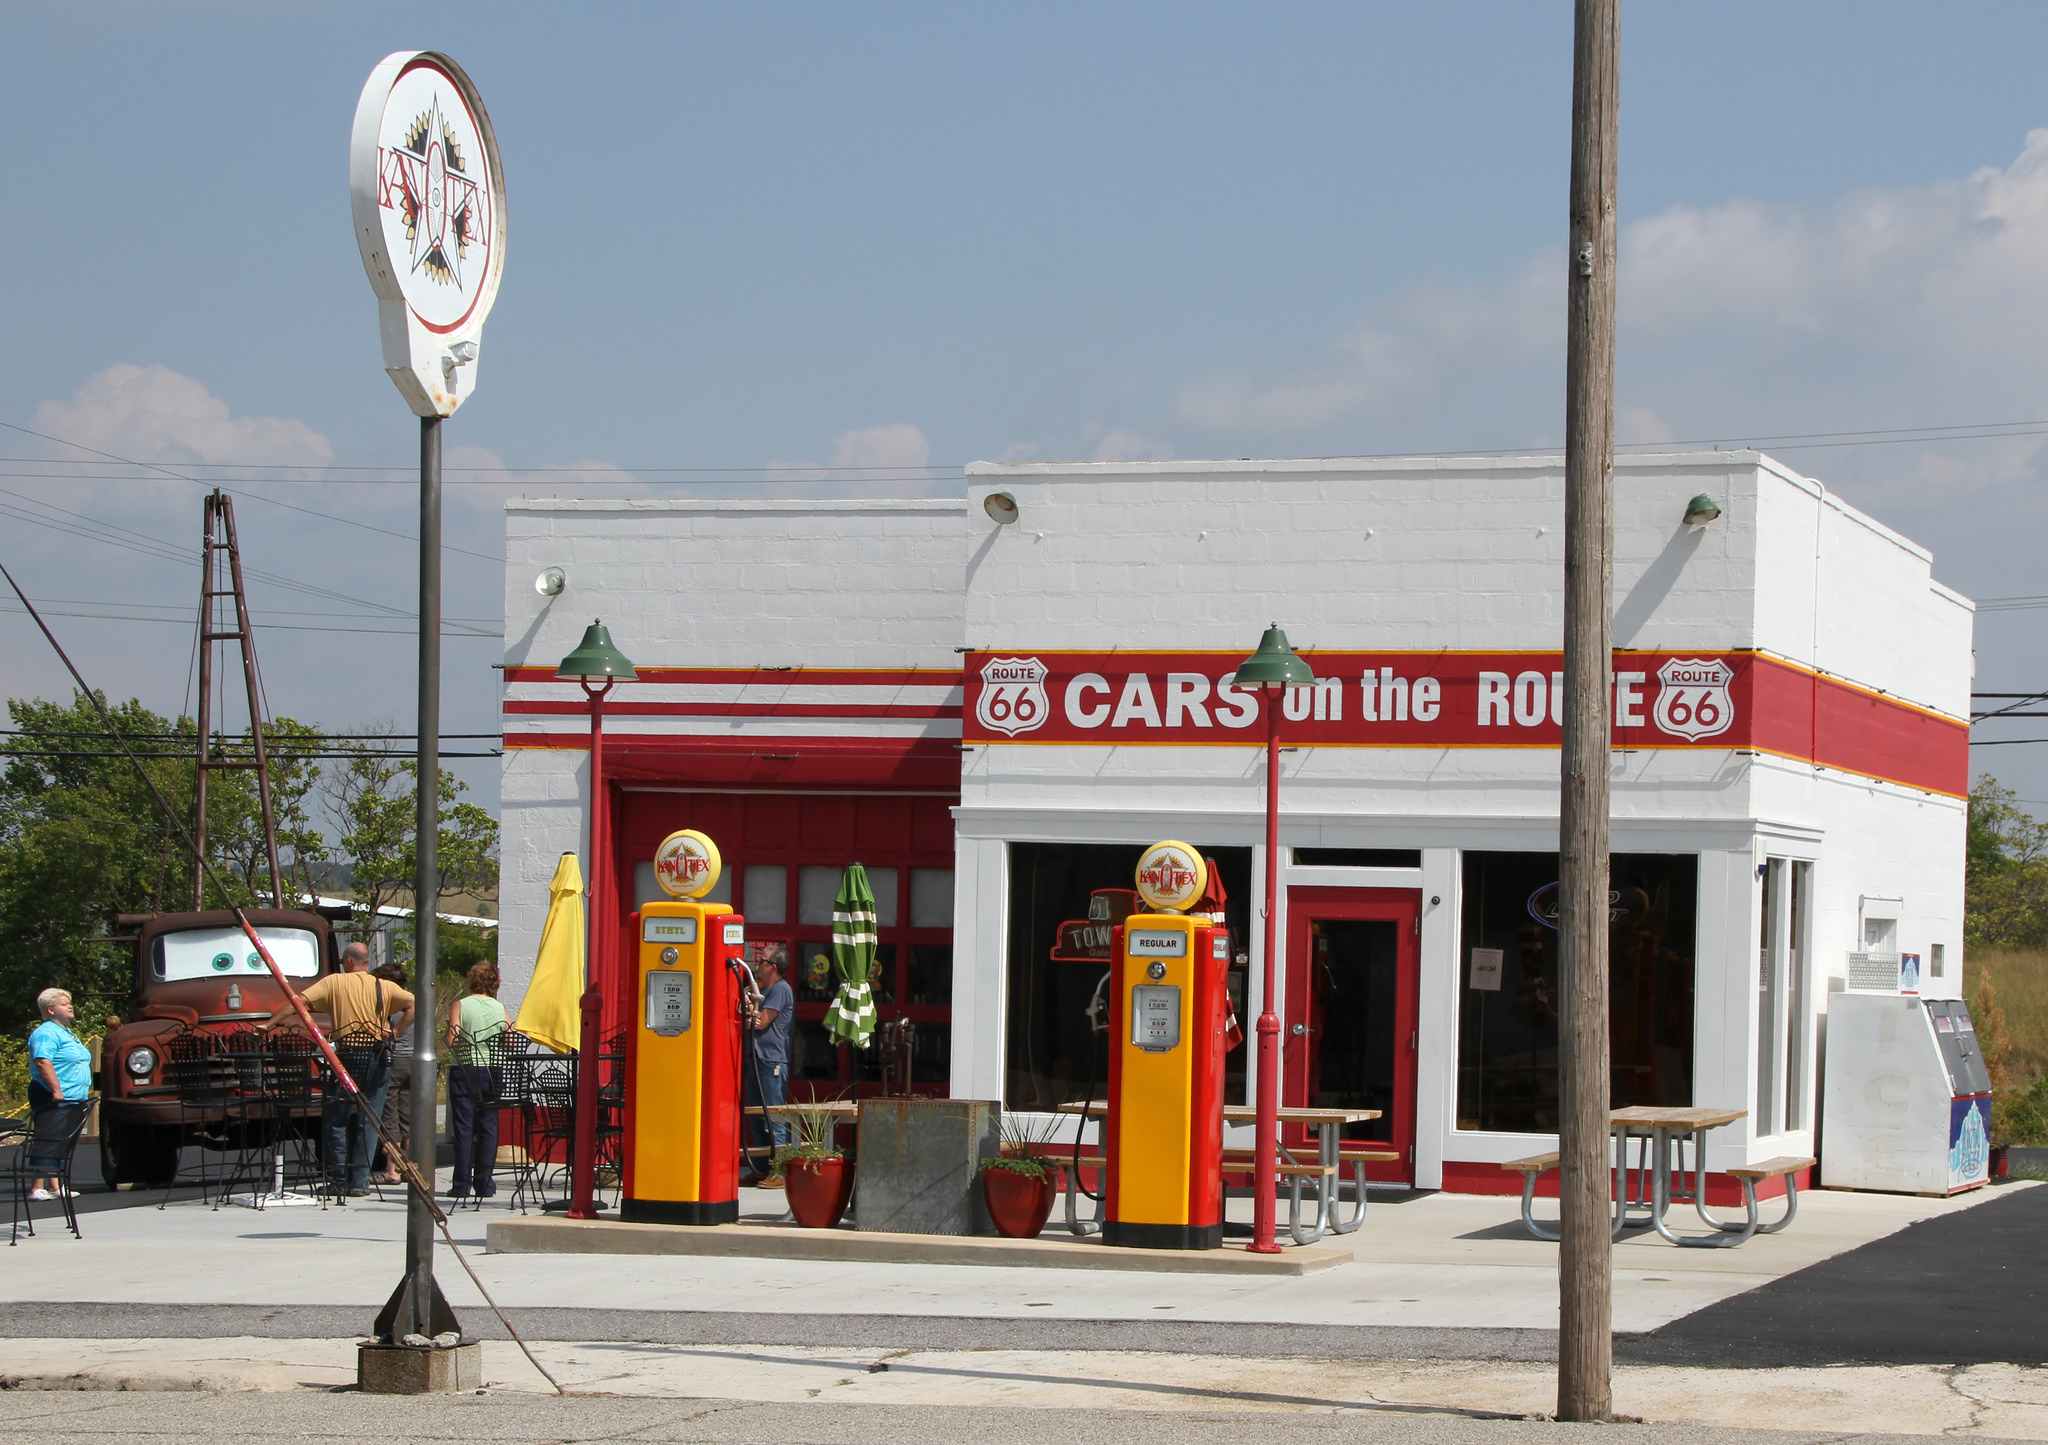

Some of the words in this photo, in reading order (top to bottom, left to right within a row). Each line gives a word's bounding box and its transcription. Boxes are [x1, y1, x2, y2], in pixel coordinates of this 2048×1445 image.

[991, 667, 1035, 680] ROUTE
[1671, 670, 1720, 683] ROUTE
[989, 686, 1037, 722] 66
[1064, 672, 1260, 729] CARS
[1282, 675, 1343, 722] on
[1361, 667, 1441, 722] the
[1477, 670, 1646, 728] ROE
[1667, 689, 1720, 726] 66
[655, 926, 685, 935] ETHYL
[1140, 939, 1176, 948] REGULAR
